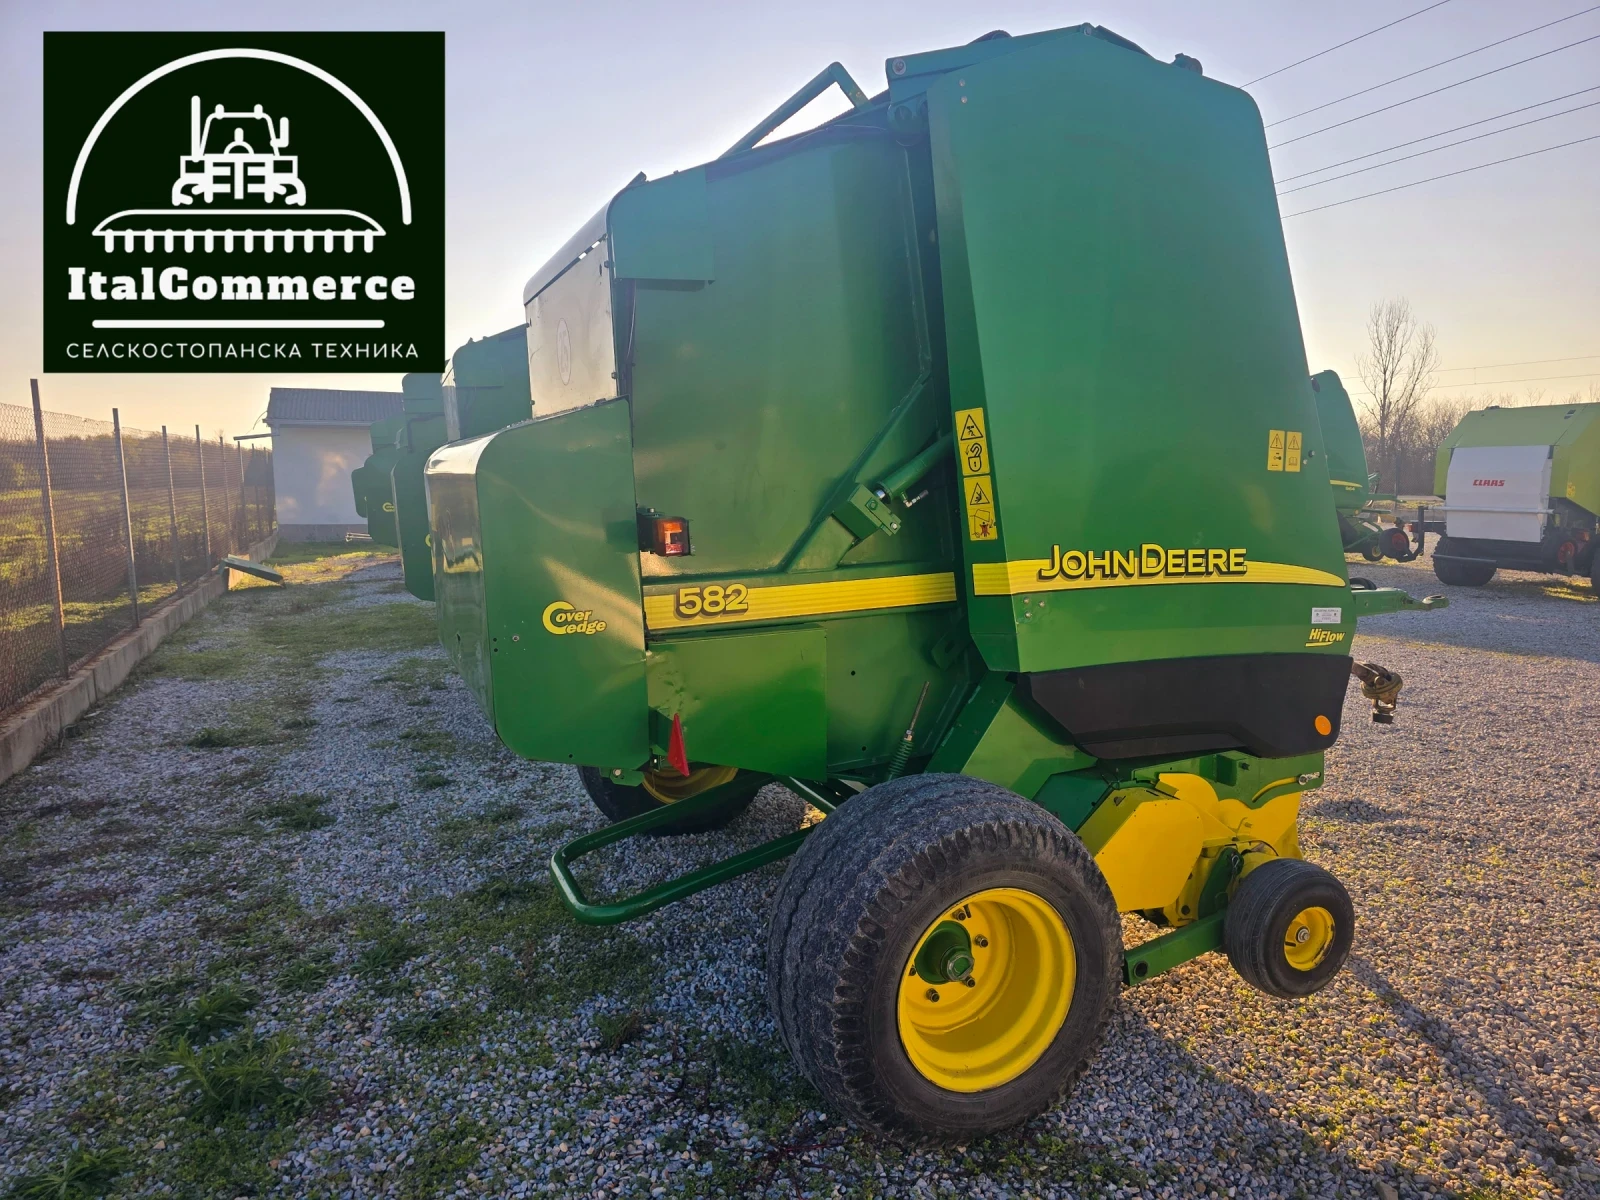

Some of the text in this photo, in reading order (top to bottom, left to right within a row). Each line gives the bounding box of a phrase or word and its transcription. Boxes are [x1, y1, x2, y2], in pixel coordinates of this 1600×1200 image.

[1472, 479, 1506, 487] CLAAS
[1038, 543, 1248, 581] JOHN DEERE
[675, 583, 749, 619] 582
[542, 600, 593, 635] Cover
[566, 620, 607, 635] edge
[1308, 628, 1346, 642] HiFlow
